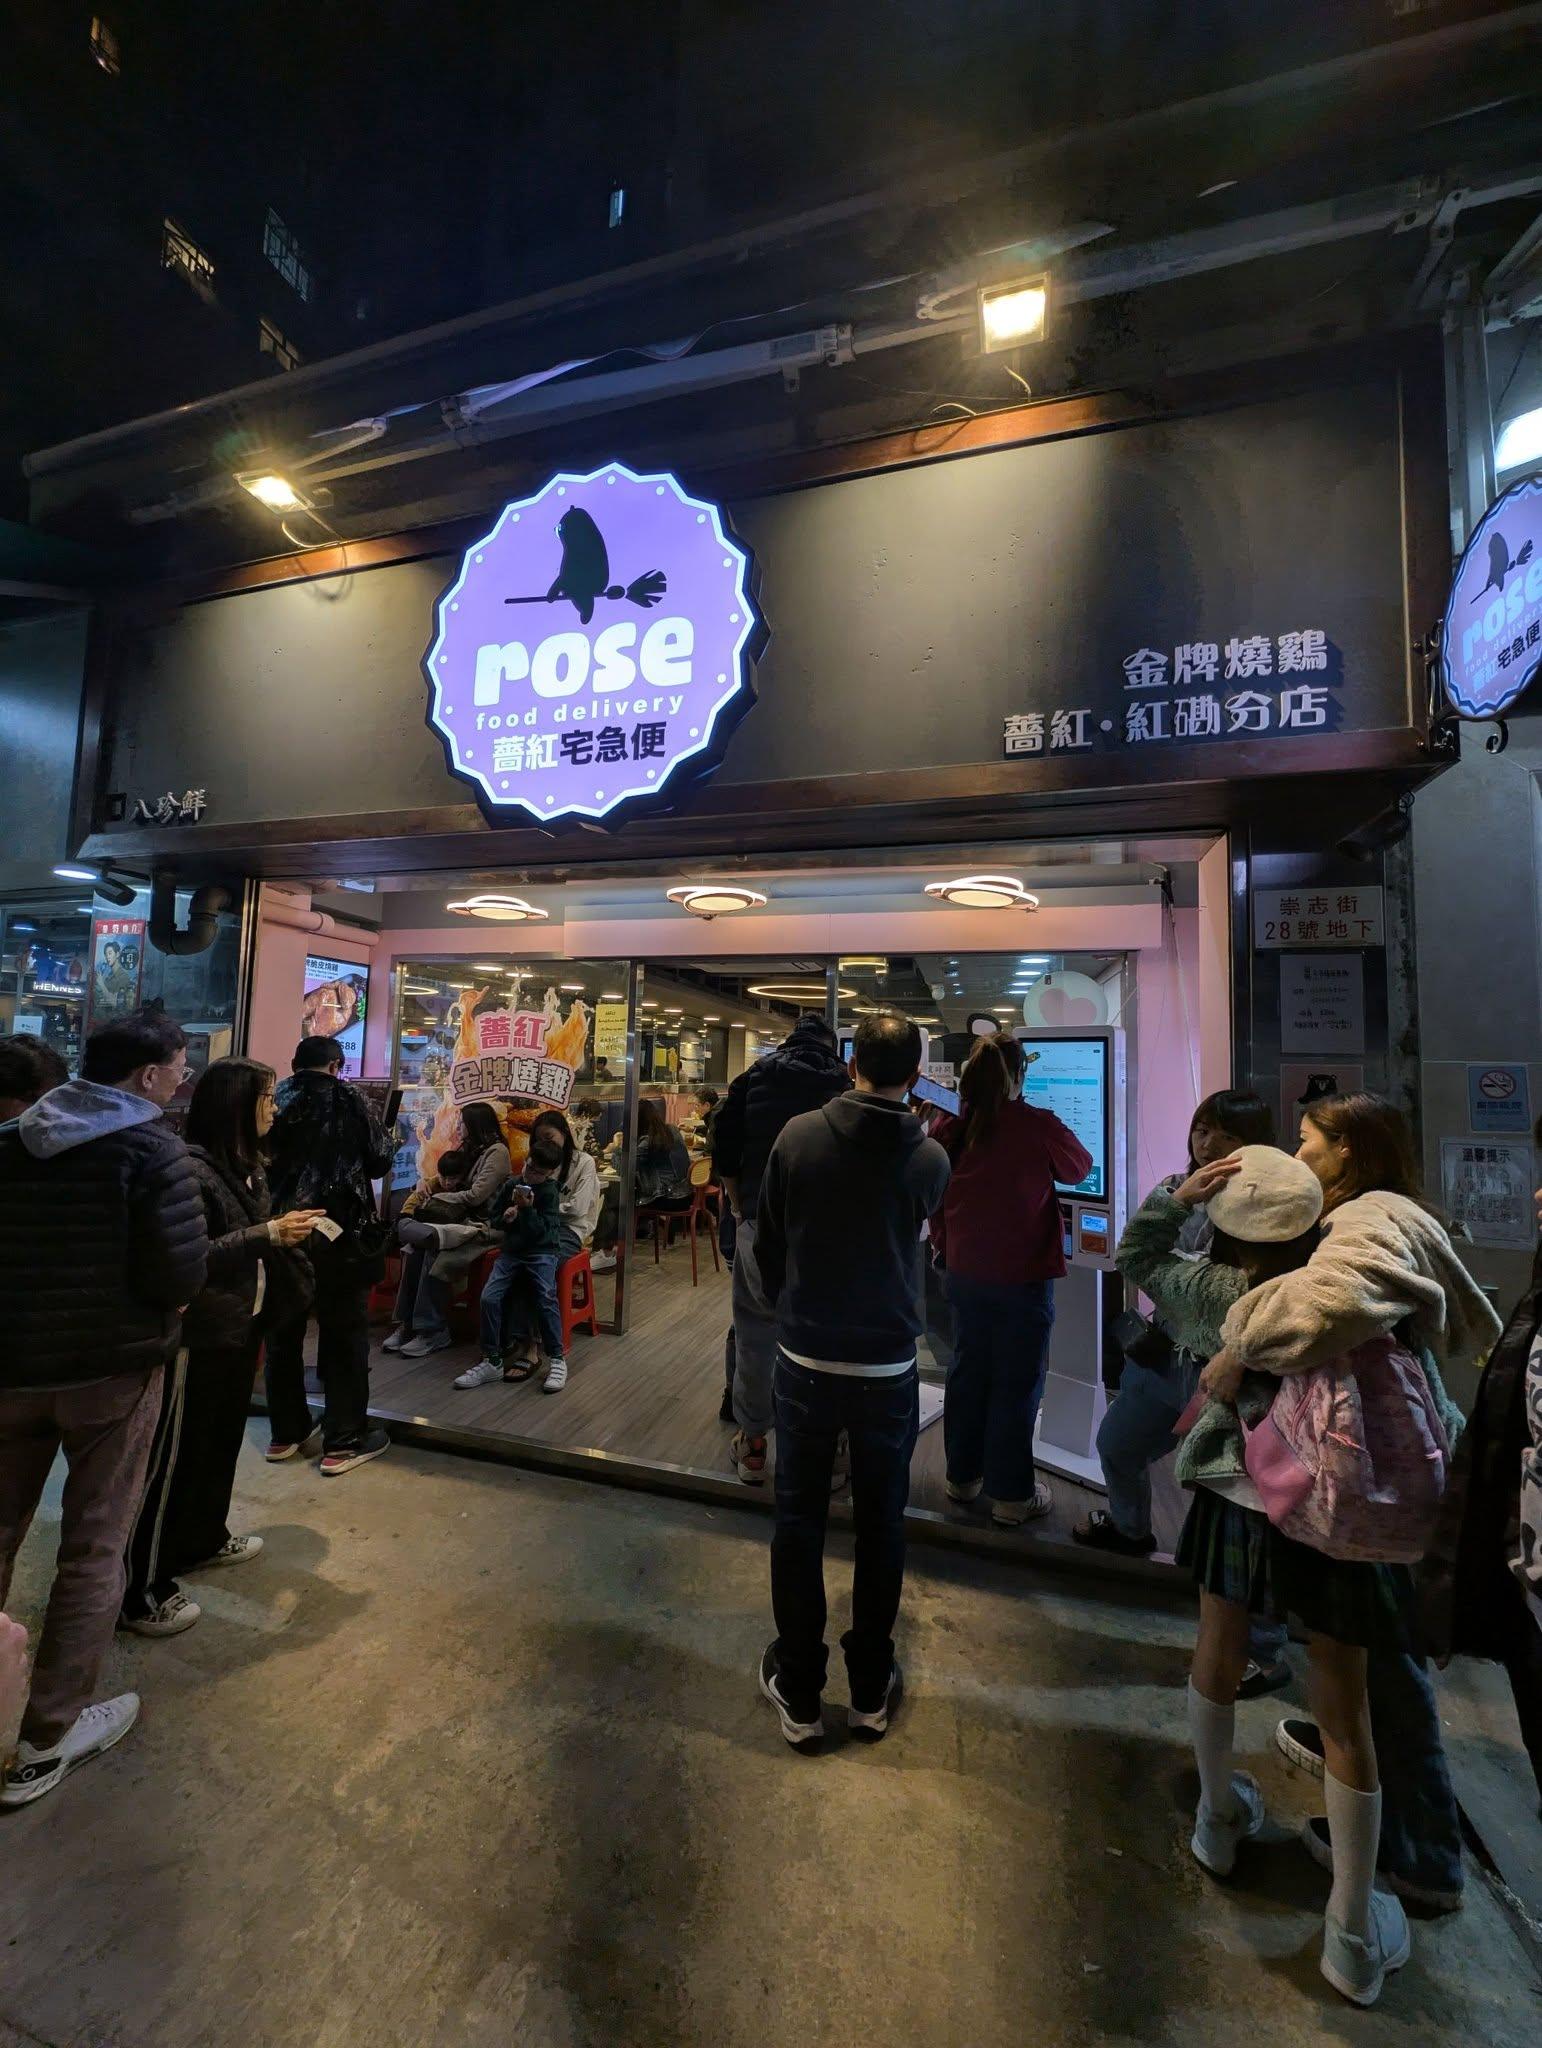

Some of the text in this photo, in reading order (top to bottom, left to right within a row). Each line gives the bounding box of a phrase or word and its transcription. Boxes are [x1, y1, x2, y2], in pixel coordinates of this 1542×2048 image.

[473, 616, 695, 707] rose
[476, 694, 684, 730] food delivery
[1279, 895, 1360, 916] 崇志街
[479, 1015, 546, 1051] 薔紅
[451, 1056, 571, 1105] 金牌燒雞
